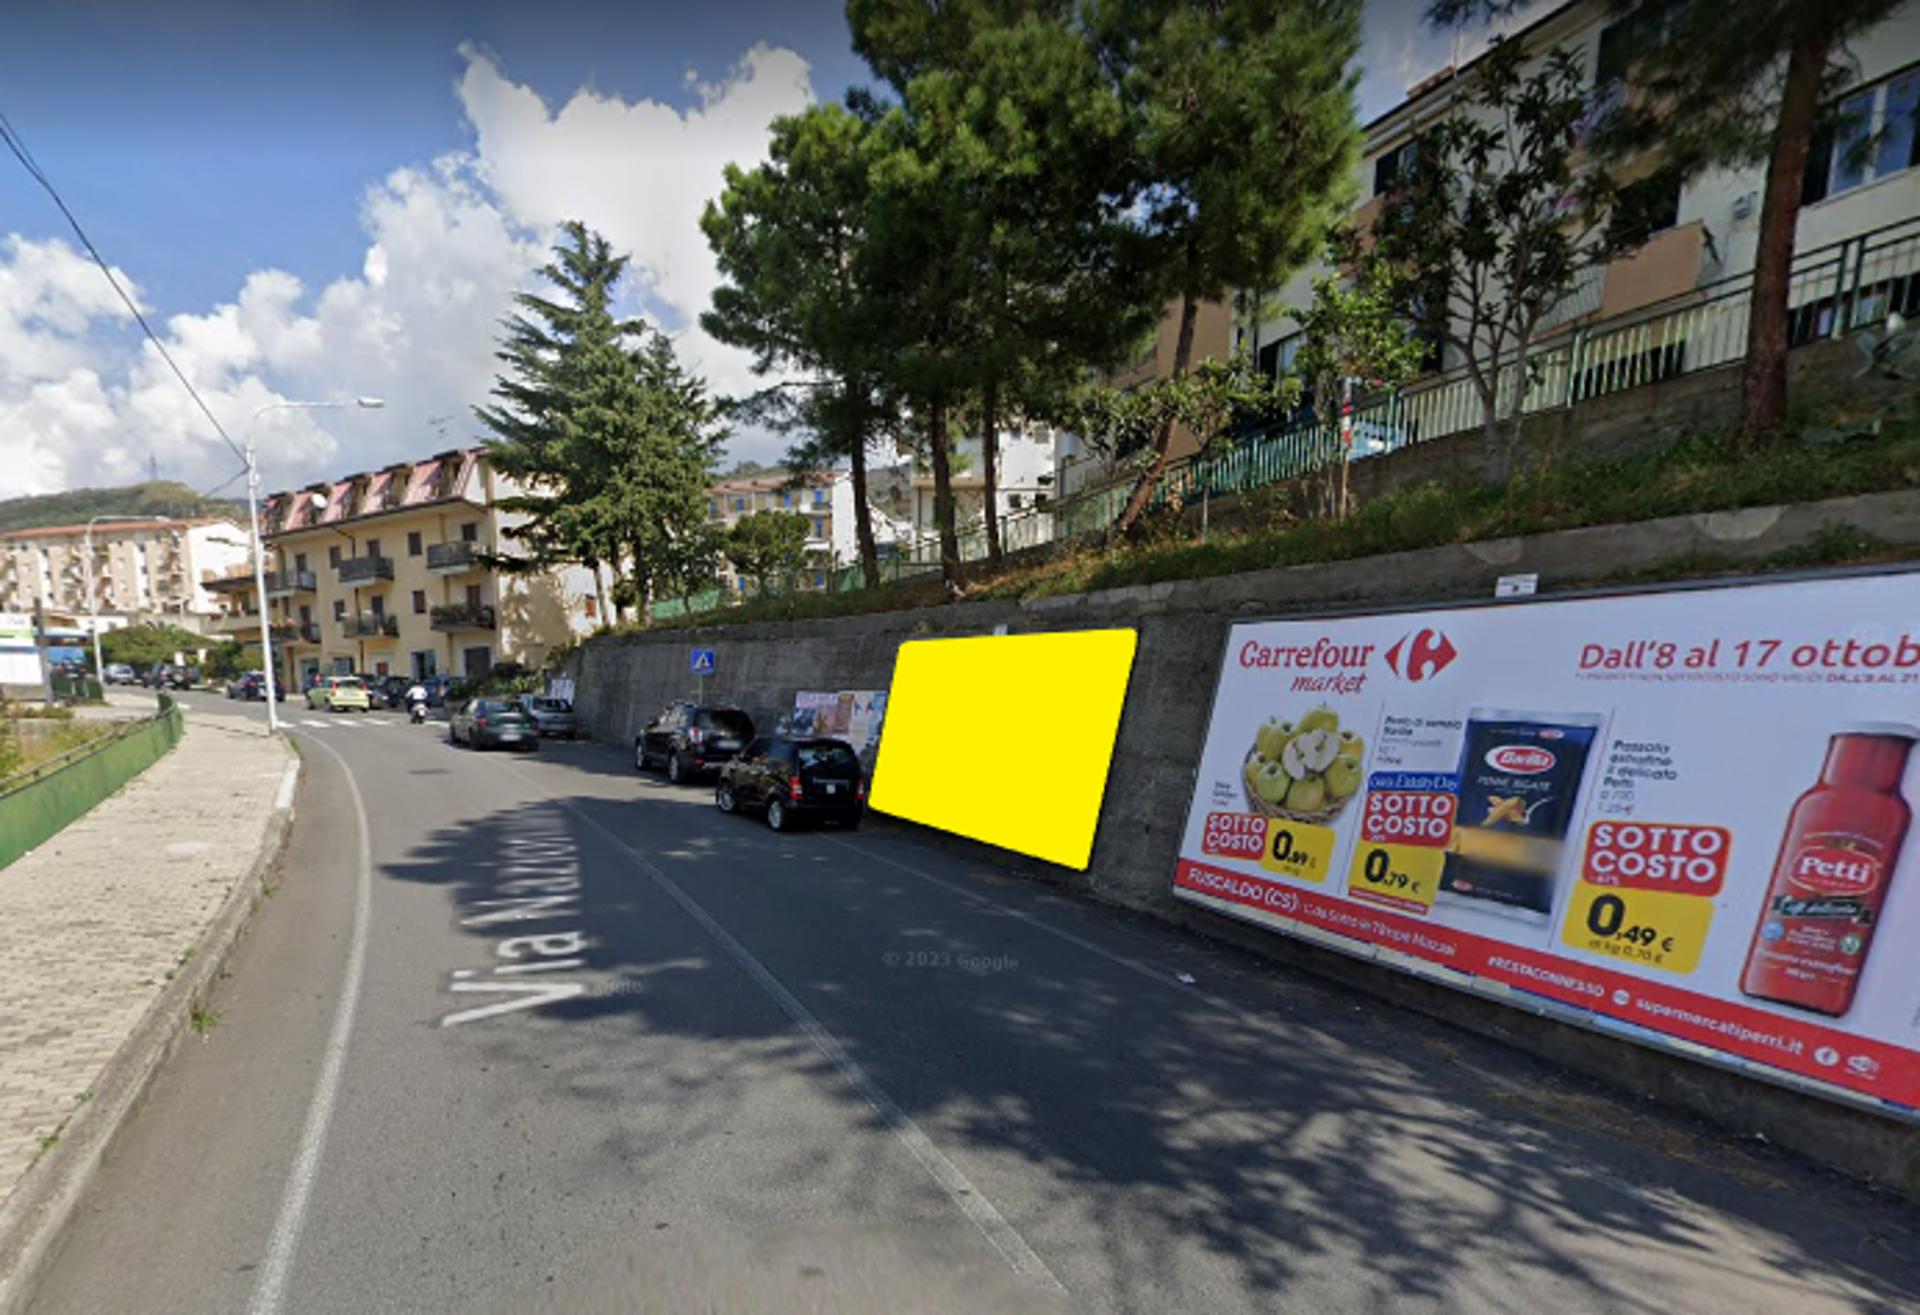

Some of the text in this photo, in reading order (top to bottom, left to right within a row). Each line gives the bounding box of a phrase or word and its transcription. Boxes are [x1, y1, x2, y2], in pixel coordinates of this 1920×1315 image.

[1239, 638, 1375, 670] Carrefour
[1579, 640, 1677, 670] Dall'8
[1685, 638, 1720, 668] al
[1734, 639, 1781, 668] 17
[1289, 672, 1367, 694] market
[1370, 794, 1452, 815] SOTTO
[1208, 814, 1266, 833] SOTTO
[1367, 814, 1448, 837] COSTO
[1206, 831, 1263, 852] COSTO
[1594, 826, 1722, 856] SOTTO
[1590, 851, 1717, 883] COSTO
[1799, 857, 1871, 883] Petti
[1188, 868, 1263, 901] FUSCALDO
[1661, 937, 1675, 953] €
